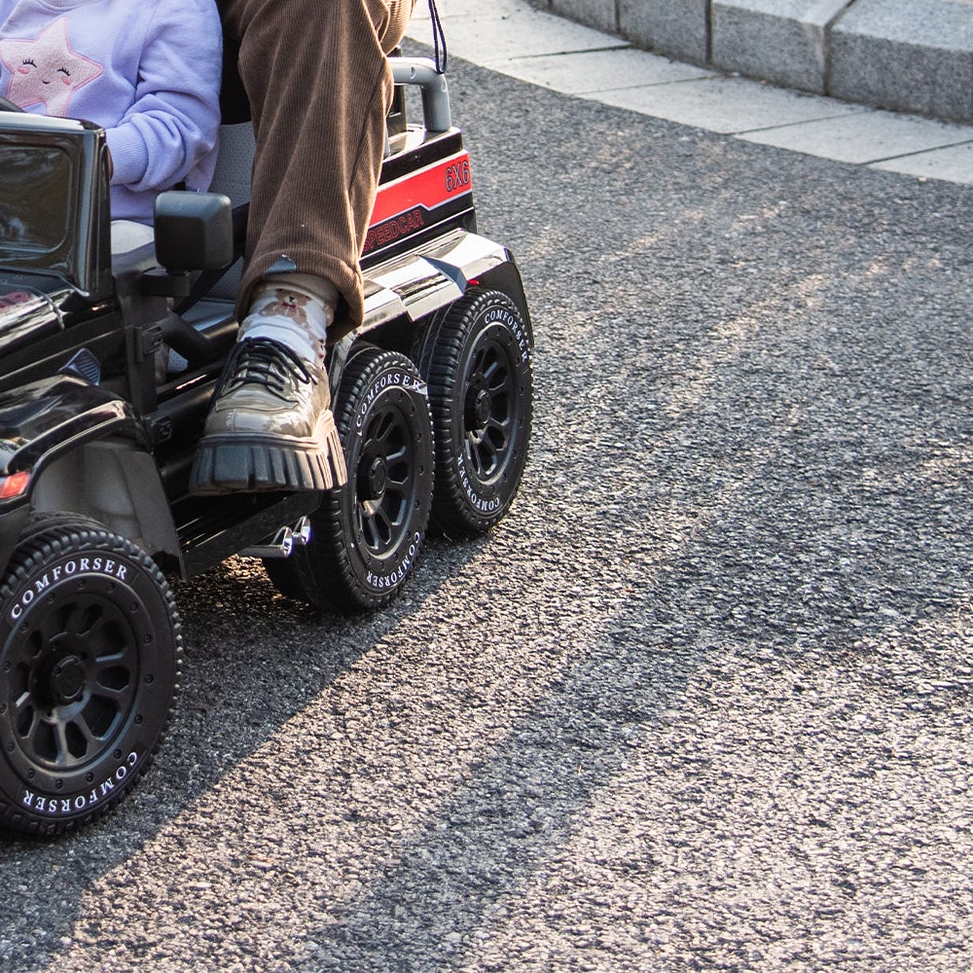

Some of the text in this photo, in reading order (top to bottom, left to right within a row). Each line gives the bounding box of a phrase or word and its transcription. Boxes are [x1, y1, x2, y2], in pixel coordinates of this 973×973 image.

[444, 160, 470, 192] 6X6
[485, 309, 528, 363] COMFORSER
[356, 372, 422, 427] COMFORSER
[457, 452, 500, 512] COMFORSER
[11, 557, 128, 620] COMFORSER
[366, 530, 421, 589] COMFORSER
[23, 751, 137, 813] COMFORSER
